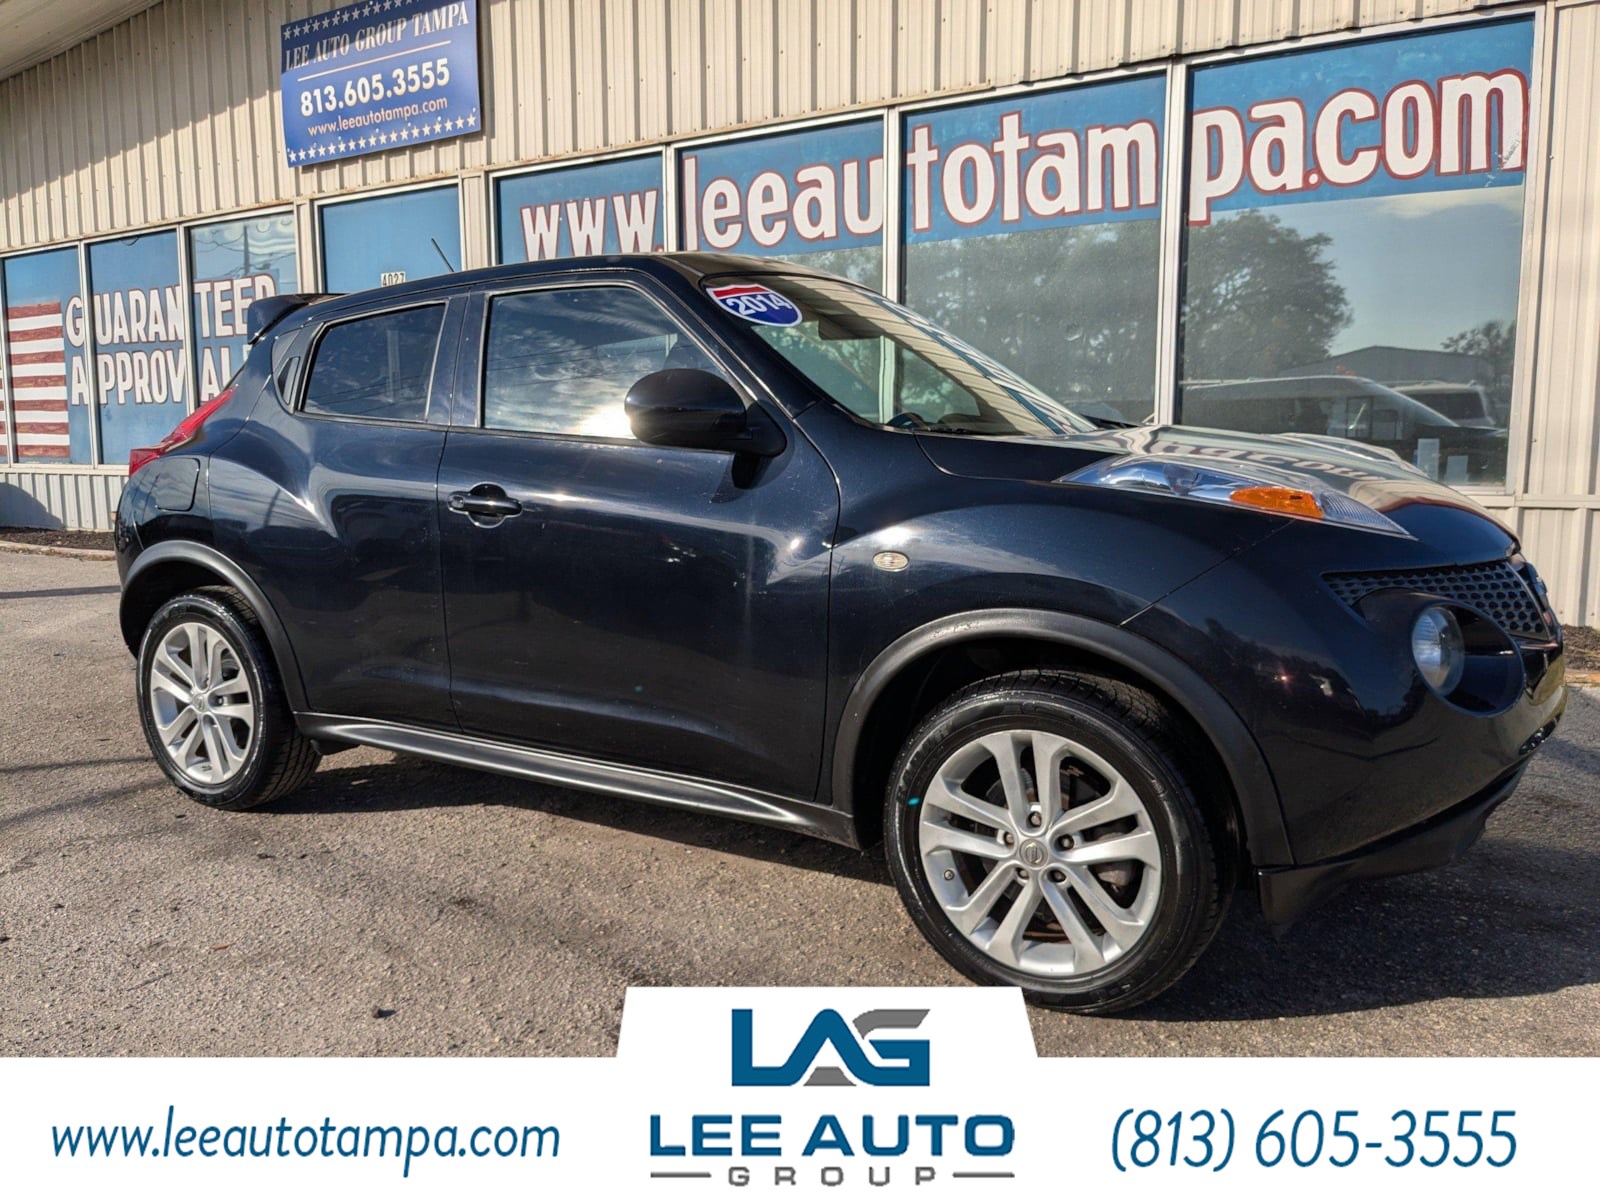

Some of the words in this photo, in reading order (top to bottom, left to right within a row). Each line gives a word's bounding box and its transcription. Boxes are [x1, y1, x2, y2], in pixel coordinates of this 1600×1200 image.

[285, 44, 310, 71] LEE
[313, 33, 350, 63] AUTO
[355, 18, 407, 52] GROUP
[412, 1, 470, 37] TAMPA
[300, 57, 450, 117] 813.605.3555
[308, 97, 449, 137] www.leeautotampa.com
[382, 272, 405, 286] 4027
[725, 293, 793, 316] 2014
